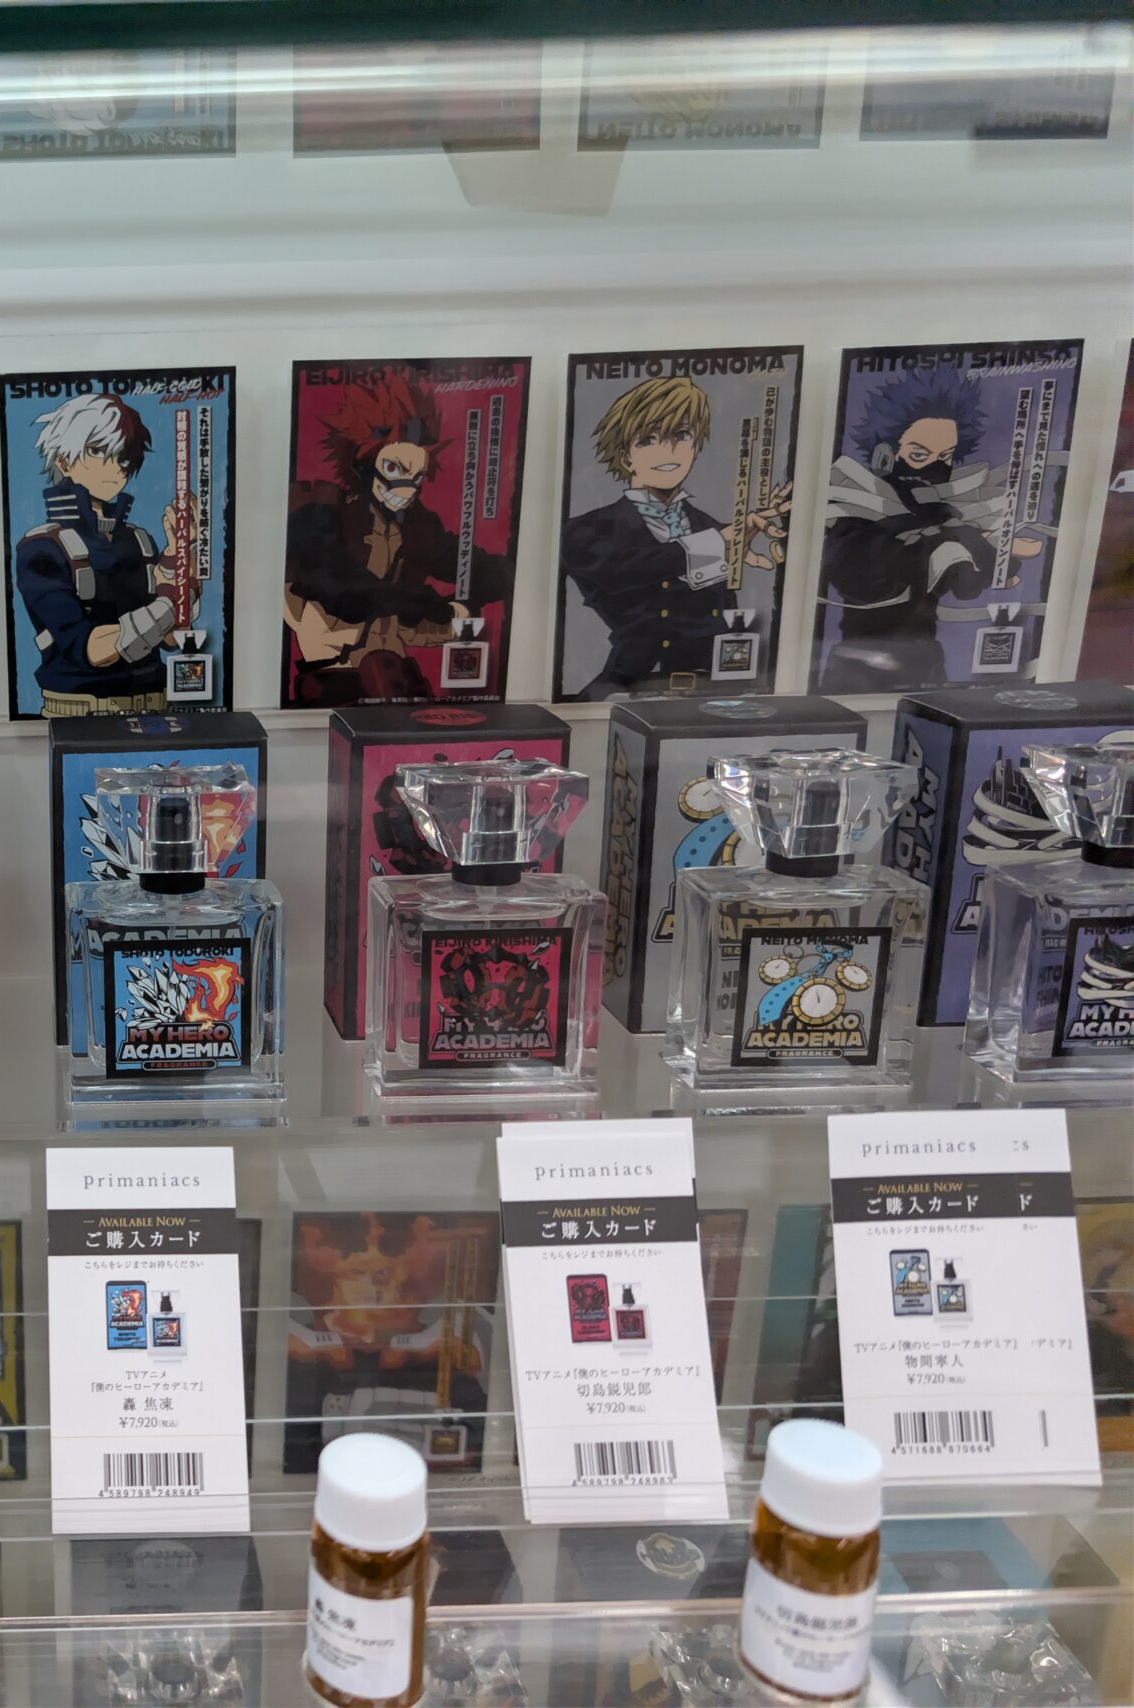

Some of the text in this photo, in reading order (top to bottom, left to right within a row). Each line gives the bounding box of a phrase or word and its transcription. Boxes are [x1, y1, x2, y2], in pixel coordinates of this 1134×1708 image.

[585, 357, 663, 380] NEITO
[670, 353, 786, 378] MONOMA
[966, 356, 1078, 381] BRAINWASHING
[10, 380, 93, 400] SHOTO
[760, 935, 803, 946] NEITO
[121, 947, 165, 958] SHOTO
[1080, 1004, 1116, 1021] MY
[128, 1025, 231, 1043] MY HERO
[434, 1031, 550, 1050] ACADEMIA
[747, 1031, 863, 1048] ACADEMIA
[121, 1041, 237, 1060] ACADEMIA
[861, 1138, 977, 1158] primaniacs
[535, 1161, 654, 1181] primaniacs
[83, 1172, 201, 1190] primaniacs
[866, 1195, 979, 1216] ご購入カード
[541, 1219, 657, 1240] ご購入カード
[867, 1224, 984, 1236] こちらをレジまでお持ちください
[85, 1230, 202, 1249] ご購入カード
[541, 1249, 662, 1261] こちらをレジまでお持ちください
[84, 1259, 205, 1270] こちらをレジまでお持ちください
[905, 1353, 964, 1369] 物間寧人
[125, 1370, 167, 1380] TVアニメ
[577, 1381, 653, 1398] 切島鋭児郎
[122, 1396, 174, 1411] 轟 焦凍
[109, 1489, 152, 1498] 589798
[157, 1488, 200, 1497] 248949
